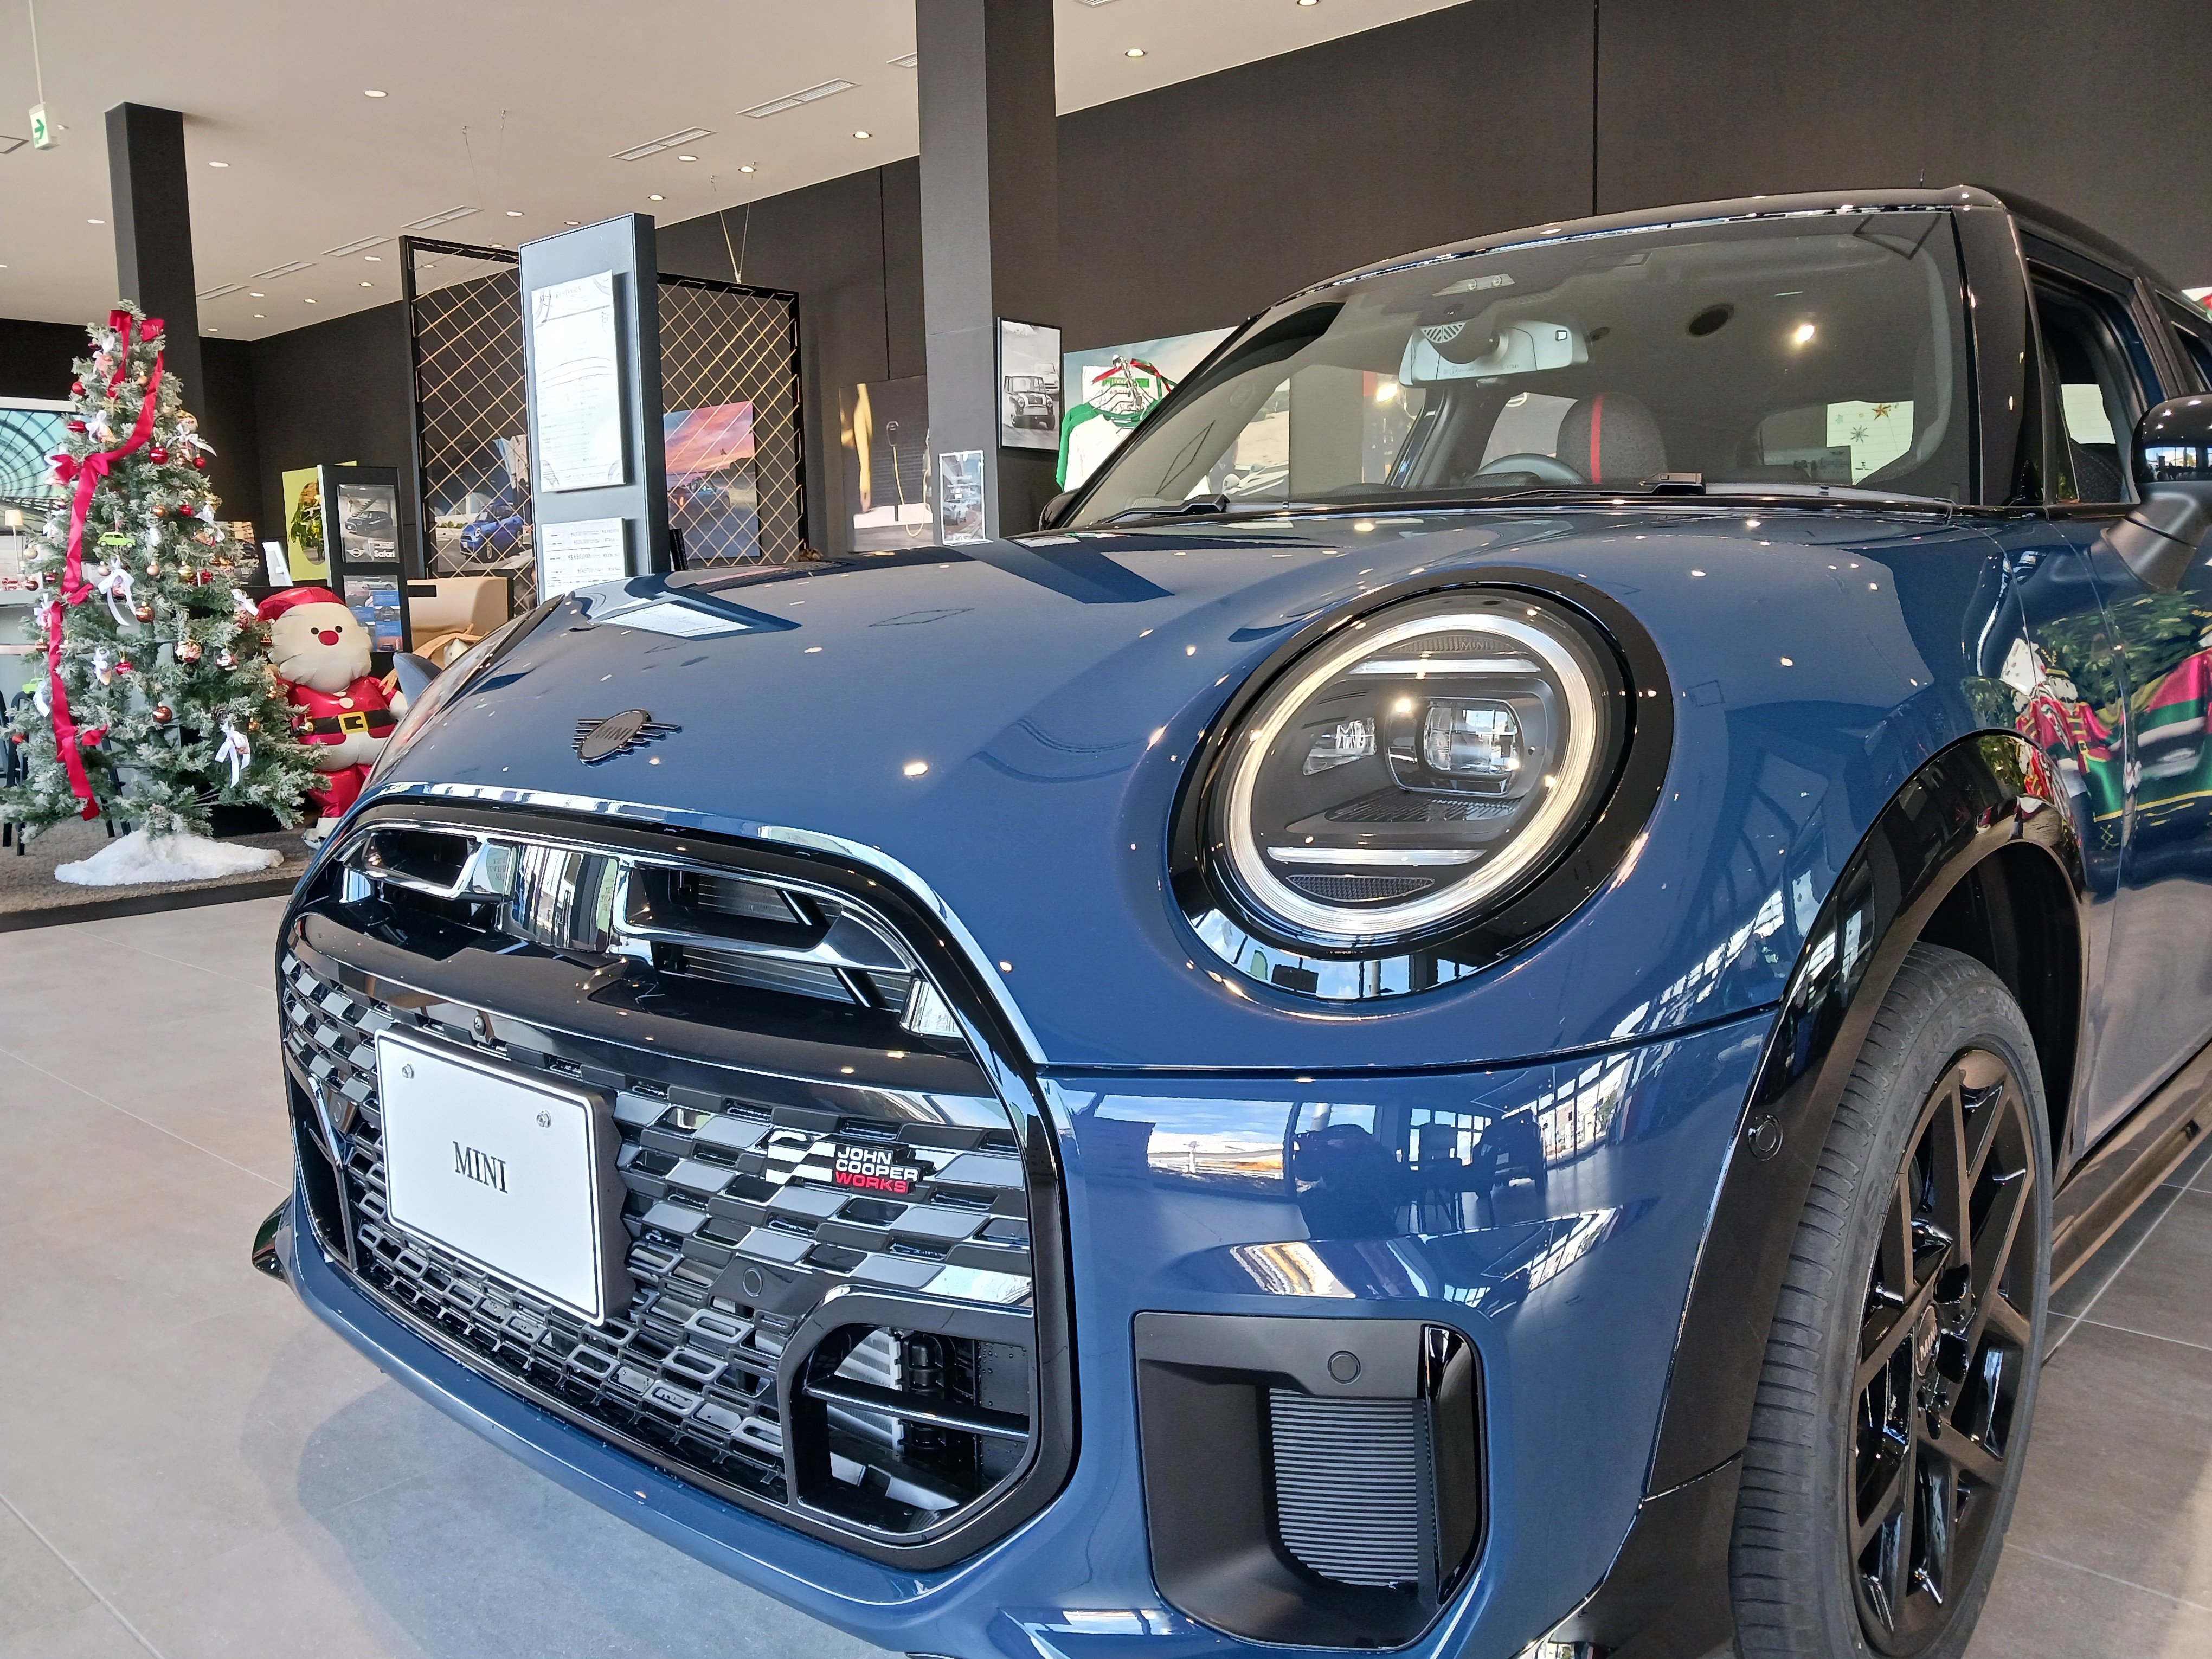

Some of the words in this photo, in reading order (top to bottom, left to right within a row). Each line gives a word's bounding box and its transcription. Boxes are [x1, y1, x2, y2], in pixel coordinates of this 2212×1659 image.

[374, 550, 395, 558] Safari
[1461, 641, 1488, 650] MINI
[593, 725, 632, 740] MINI
[837, 1147, 892, 1165] JOHN
[453, 1141, 508, 1193] MINI
[835, 1159, 918, 1181] COOPER
[835, 1171, 908, 1193] WORKS
[1920, 1323, 1938, 1361] MINI
